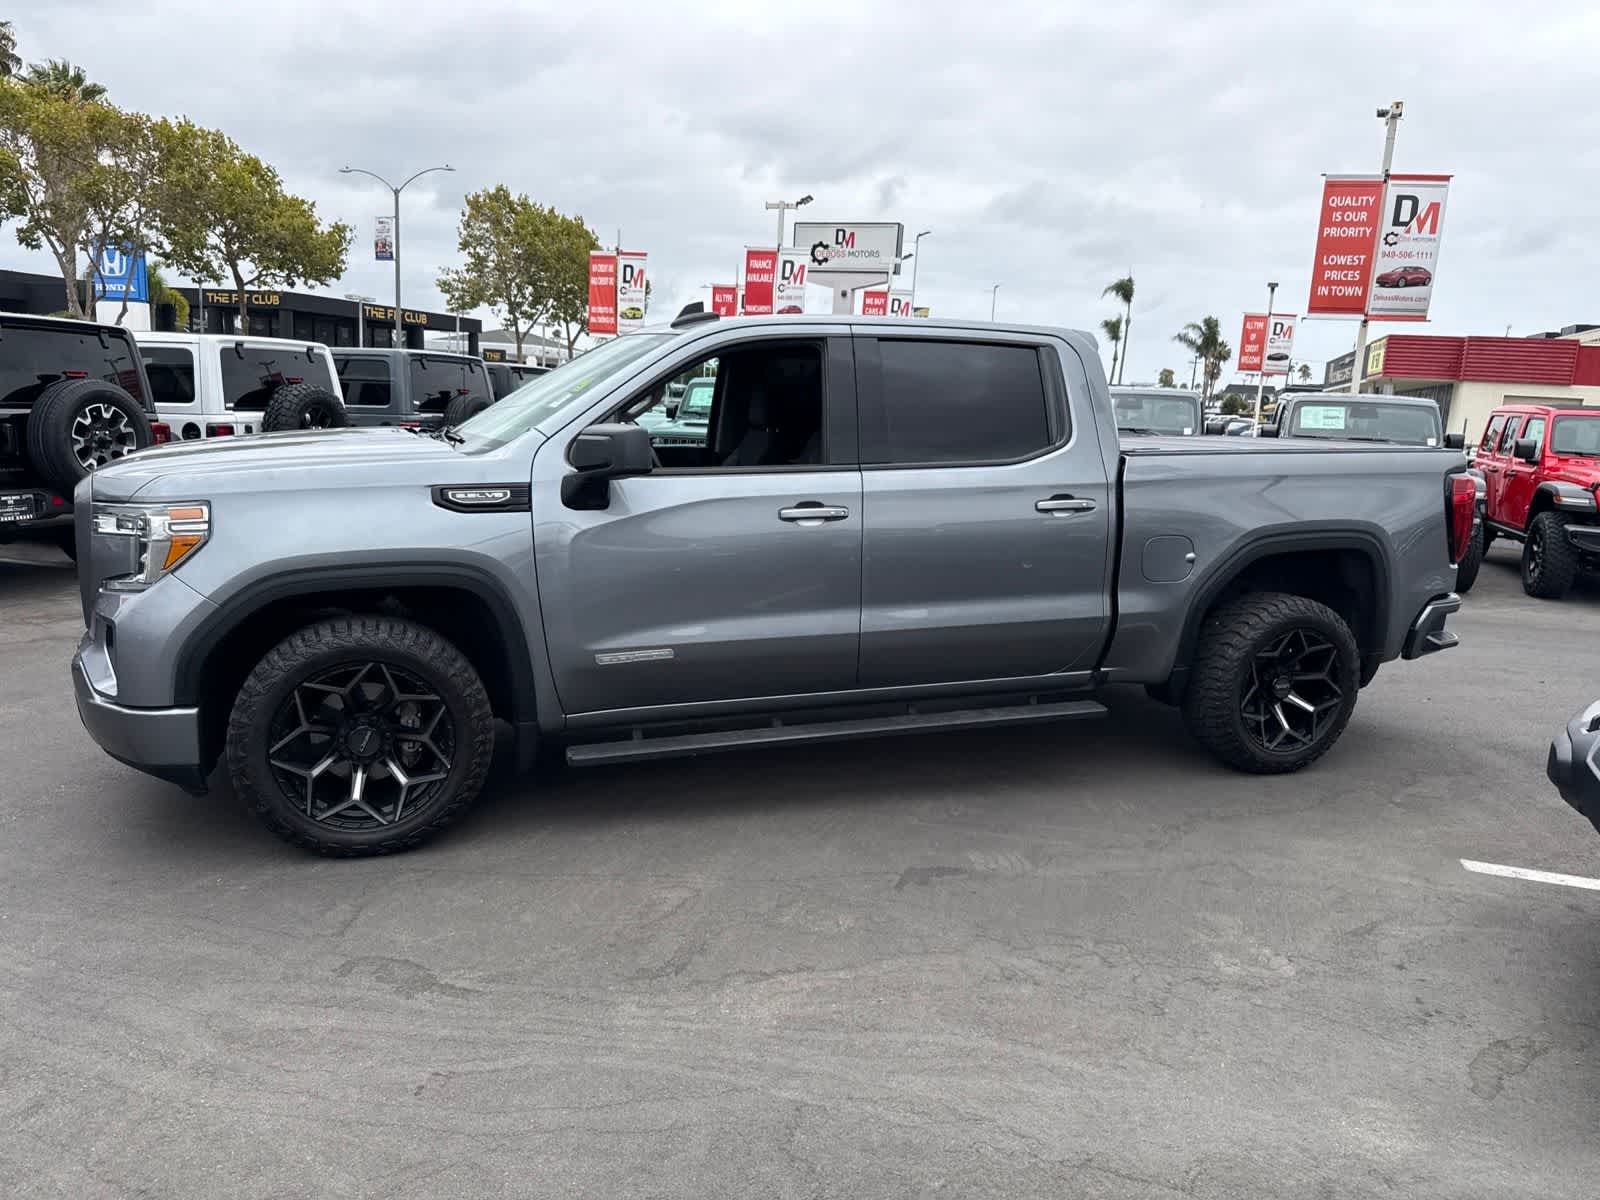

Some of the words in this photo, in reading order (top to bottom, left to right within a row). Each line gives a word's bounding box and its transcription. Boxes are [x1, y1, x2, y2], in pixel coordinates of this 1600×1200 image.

[1328, 196, 1375, 207] QUALITY
[1332, 211, 1342, 221] IS
[1344, 211, 1367, 221] OUR
[1391, 194, 1441, 235] DM
[836, 228, 856, 249] DM
[1323, 227, 1373, 238] PRIORITY
[848, 250, 880, 258] MOTORS
[750, 260, 772, 269] FINANCE
[1322, 255, 1367, 266] LOWEST
[622, 264, 644, 289] DM
[746, 273, 774, 283] AVAILABLE
[782, 260, 806, 285] DM
[1324, 270, 1361, 281] PRICES
[1317, 285, 1329, 296] IN
[1331, 286, 1363, 297] TOWN
[206, 292, 229, 304] THE
[231, 293, 250, 304] FT
[252, 294, 280, 305] CLUB
[891, 298, 910, 317] DM
[364, 306, 386, 319] THE
[387, 309, 403, 320] FI
[404, 312, 428, 324] CLUB
[1273, 321, 1293, 340] DM
